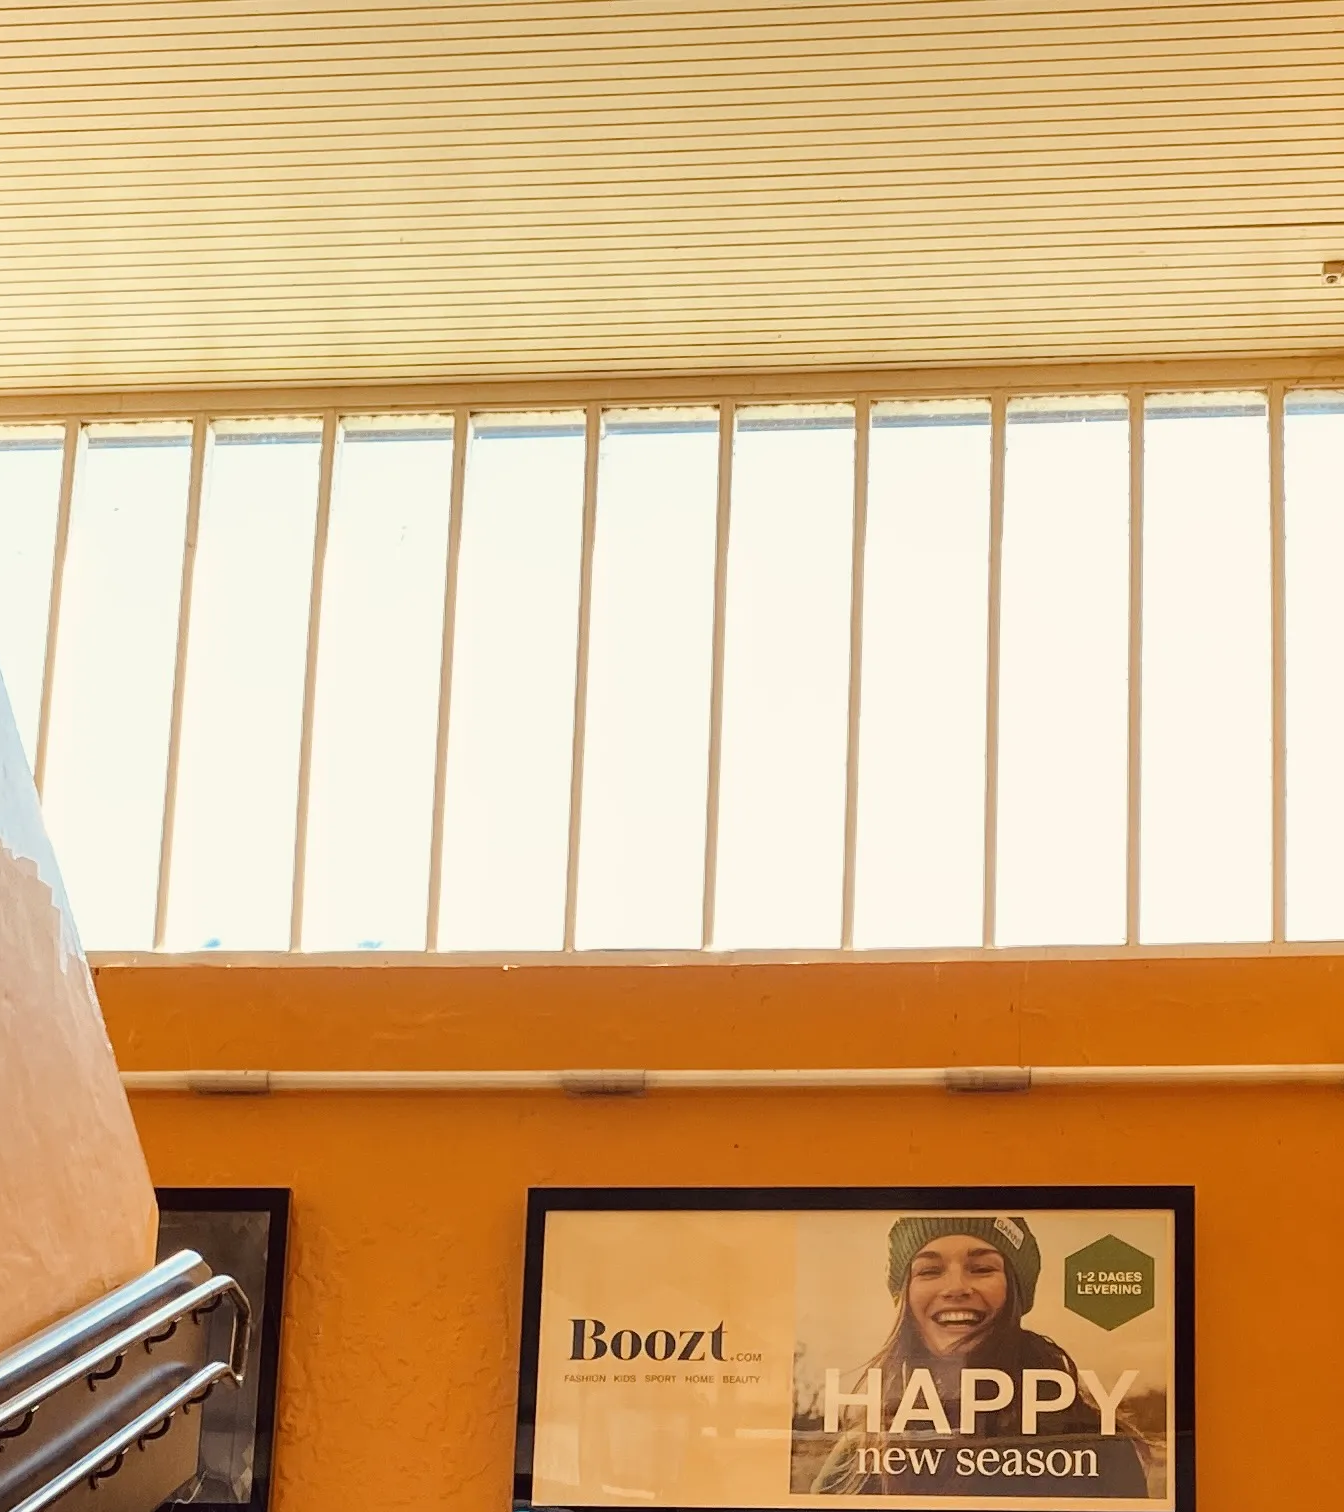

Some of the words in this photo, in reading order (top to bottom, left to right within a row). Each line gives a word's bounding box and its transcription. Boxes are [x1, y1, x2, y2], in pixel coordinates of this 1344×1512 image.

[1076, 1271, 1095, 1282] 1-2
[1098, 1271, 1143, 1283] DAGES
[1076, 1284, 1142, 1295] LEVERING
[564, 1374, 606, 1383] FASHION
[613, 1374, 637, 1383] KIDS
[644, 1375, 677, 1383] SPORT
[685, 1375, 715, 1384] HOME
[722, 1375, 762, 1384] BEAUTY
[823, 1367, 1141, 1436] HAPPY
[856, 1446, 946, 1476] new
[955, 1447, 1100, 1477] season
